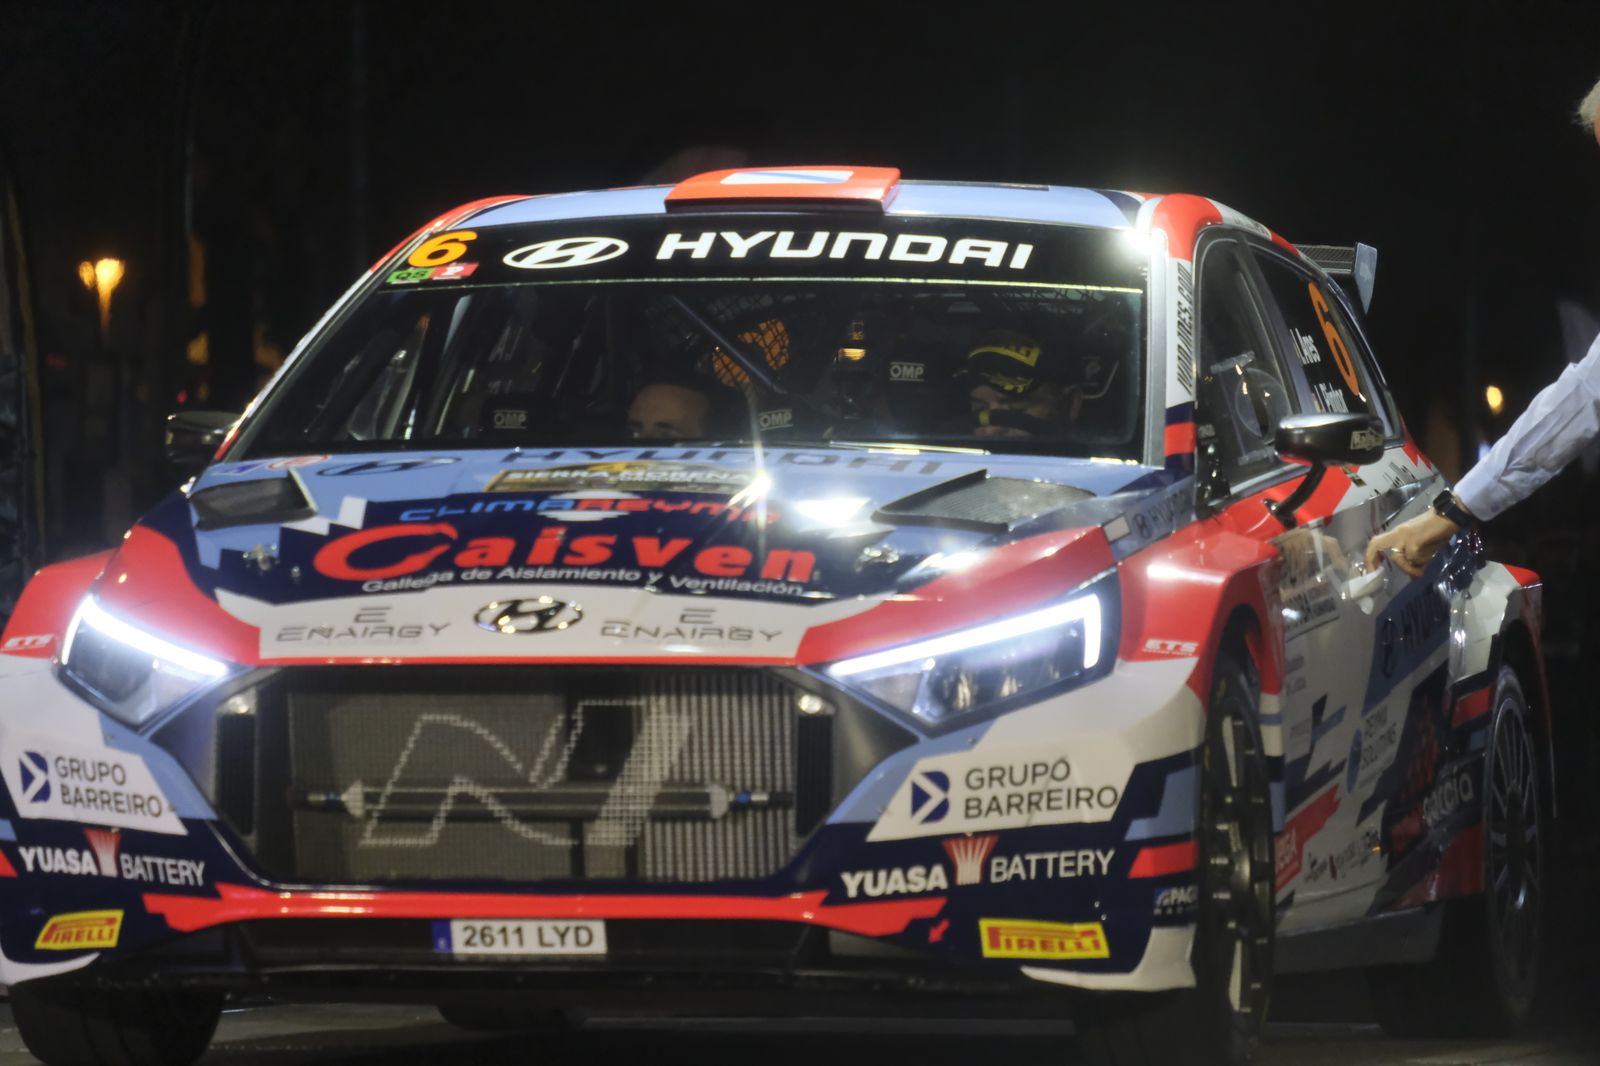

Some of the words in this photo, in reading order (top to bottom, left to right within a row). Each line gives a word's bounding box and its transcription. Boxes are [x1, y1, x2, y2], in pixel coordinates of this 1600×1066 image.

[407, 230, 478, 267] 6
[656, 231, 1034, 269] HYUNDAI
[1308, 281, 1360, 396] 6
[501, 449, 945, 476] HYUNDAI
[313, 522, 816, 583] Caisven
[361, 568, 454, 593] Gallega
[460, 564, 493, 581] de
[495, 564, 642, 582] Aislamiento
[647, 570, 664, 590] y
[669, 574, 804, 596] Ventilación
[54, 756, 126, 786] GRUPO
[964, 758, 1071, 791] GRUPO
[60, 783, 162, 818] BARREIRO
[964, 785, 1119, 819] BARREIRO
[18, 847, 98, 876] YUASA
[120, 853, 206, 887] BATTERY
[841, 864, 948, 898] YUASA
[990, 849, 1115, 884] BATTERY
[41, 917, 117, 945] PIRELLI
[462, 925, 525, 948] 2611
[537, 925, 594, 948] LYD
[987, 925, 1102, 953] PIRELLI
